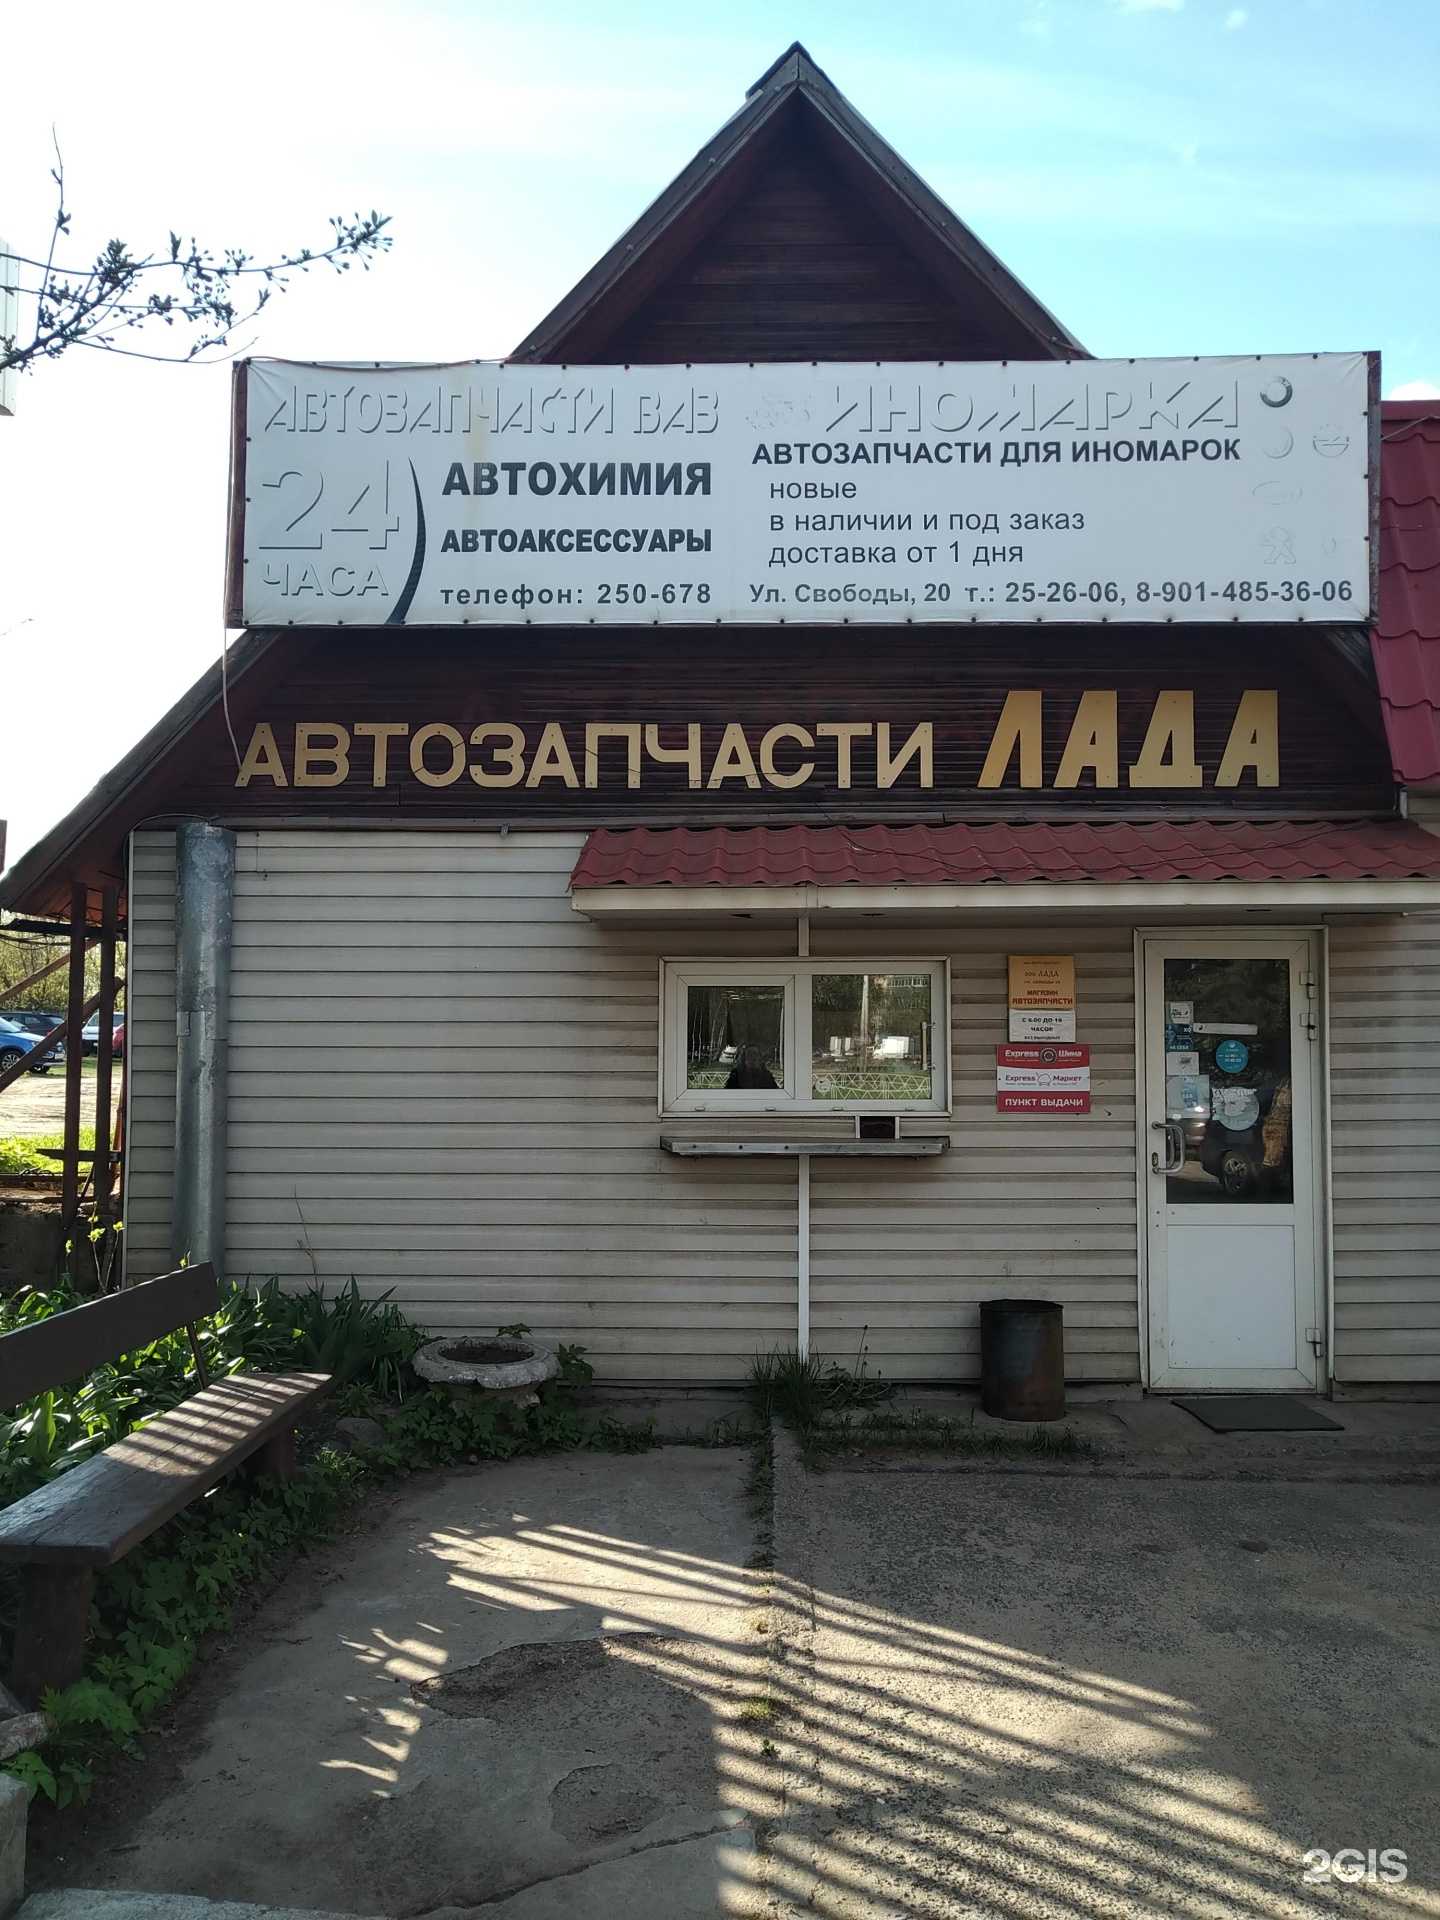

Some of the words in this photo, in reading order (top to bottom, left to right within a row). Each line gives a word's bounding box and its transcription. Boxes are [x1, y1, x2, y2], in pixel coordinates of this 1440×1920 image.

[263, 384, 614, 435] АВТОЗАПЧАСТИ
[632, 385, 719, 435] ВАЗ
[824, 379, 1239, 433] ИНОМАРКА
[751, 441, 992, 465] АВТОЗАПЧАСТИ
[1000, 440, 1061, 468] ДЛЯ
[1071, 438, 1241, 464] ИНОМАРОК
[441, 461, 712, 497] АВТОХИМИЯ
[769, 480, 857, 501] новые
[257, 456, 401, 551] 24
[769, 515, 784, 532] в
[795, 513, 912, 532] наличии
[923, 513, 938, 531] и
[949, 513, 1000, 535] под
[1009, 512, 1085, 531] заказ
[440, 528, 712, 553] АВТОАКСЕССУАРЫ
[768, 546, 897, 568] доставка
[906, 545, 938, 564] от
[949, 541, 960, 563] 1
[972, 545, 1024, 568] дня
[261, 560, 390, 597] ЧАСА
[440, 583, 583, 610] телефон:
[597, 582, 711, 605] 250-678
[748, 583, 787, 604] Ул.
[794, 583, 916, 606] Свободы,
[923, 582, 951, 602] 20
[1004, 581, 1126, 606] 25-26-06,
[1136, 579, 1353, 603] 8-901-485-36-06
[234, 722, 934, 789] АВТОЗАПЧАСТИ
[976, 689, 1280, 788] ЛАДА
[1012, 997, 1073, 1005] АВТОЗАПЧАСТИ
[1005, 1074, 1036, 1083] Express
[1005, 1098, 1038, 1107] ПУНКТ
[1040, 1098, 1084, 1108] ВЫДАЧИ
